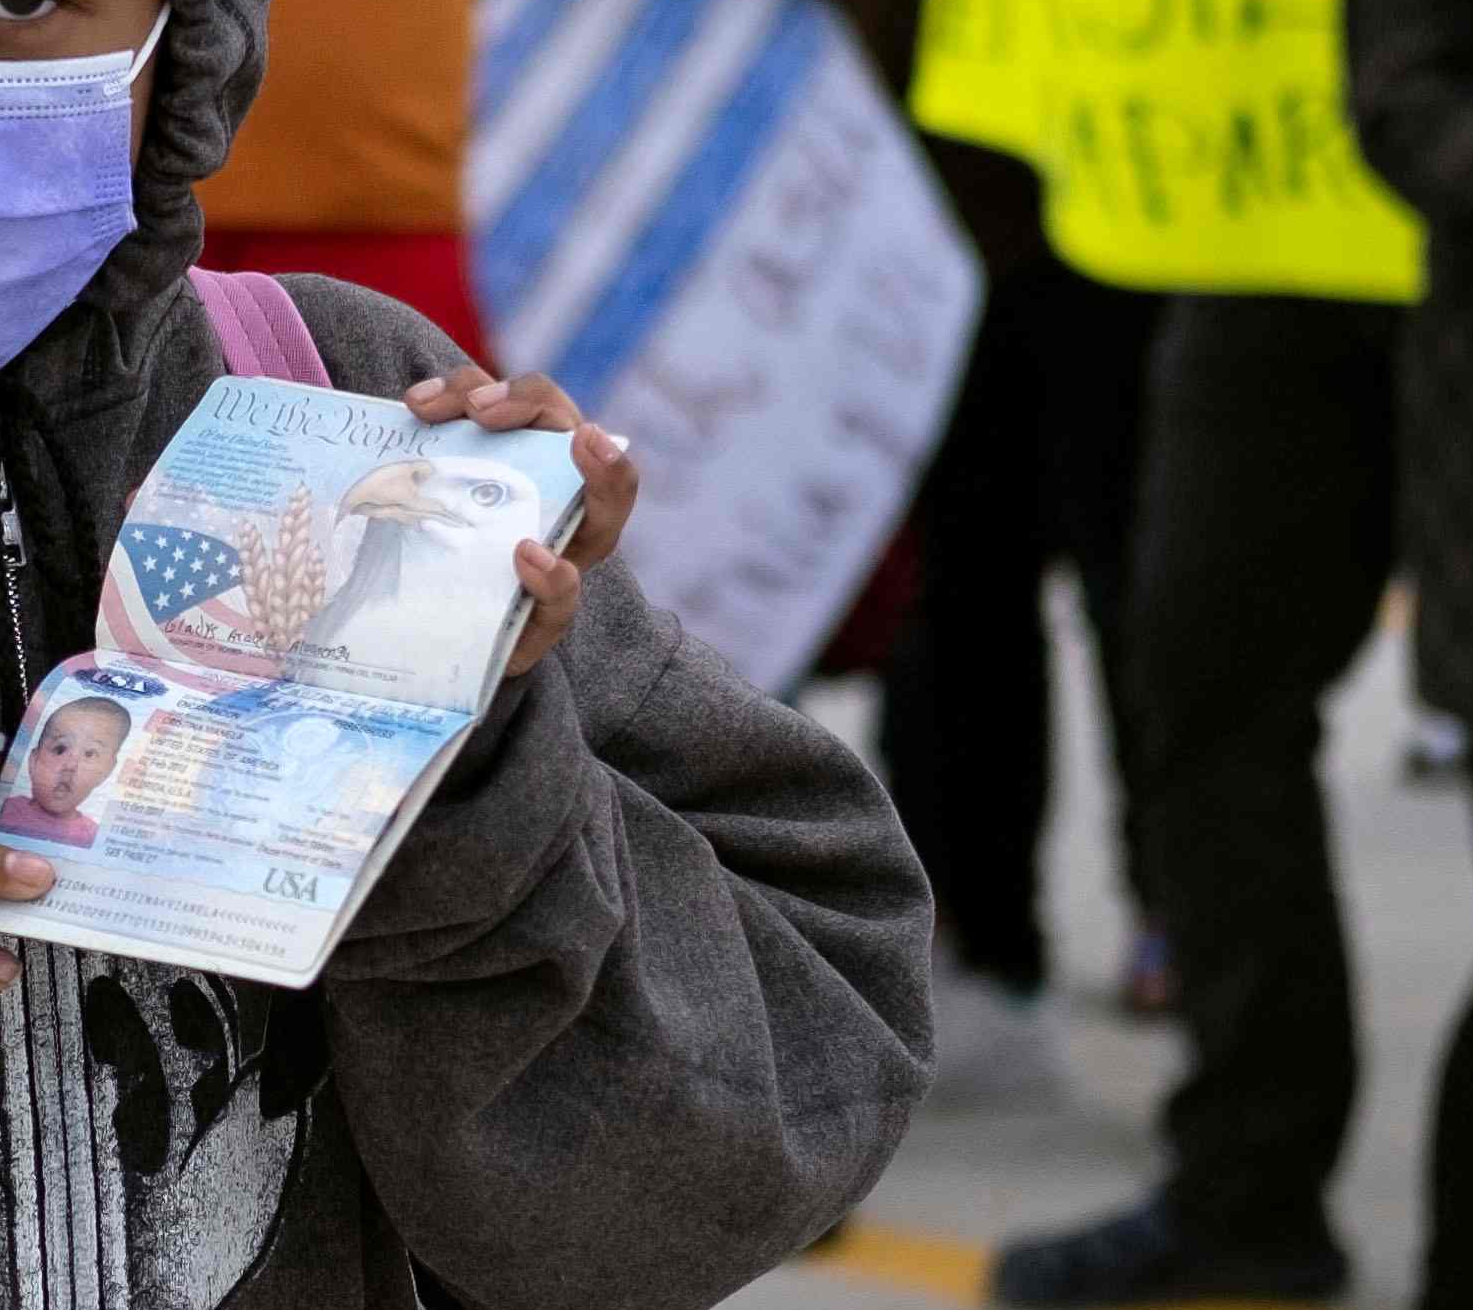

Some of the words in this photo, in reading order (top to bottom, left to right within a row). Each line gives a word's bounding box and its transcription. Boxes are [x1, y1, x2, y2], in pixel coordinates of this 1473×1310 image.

[213, 386, 268, 426] We
[317, 404, 440, 459] People
[262, 867, 319, 903] USA
